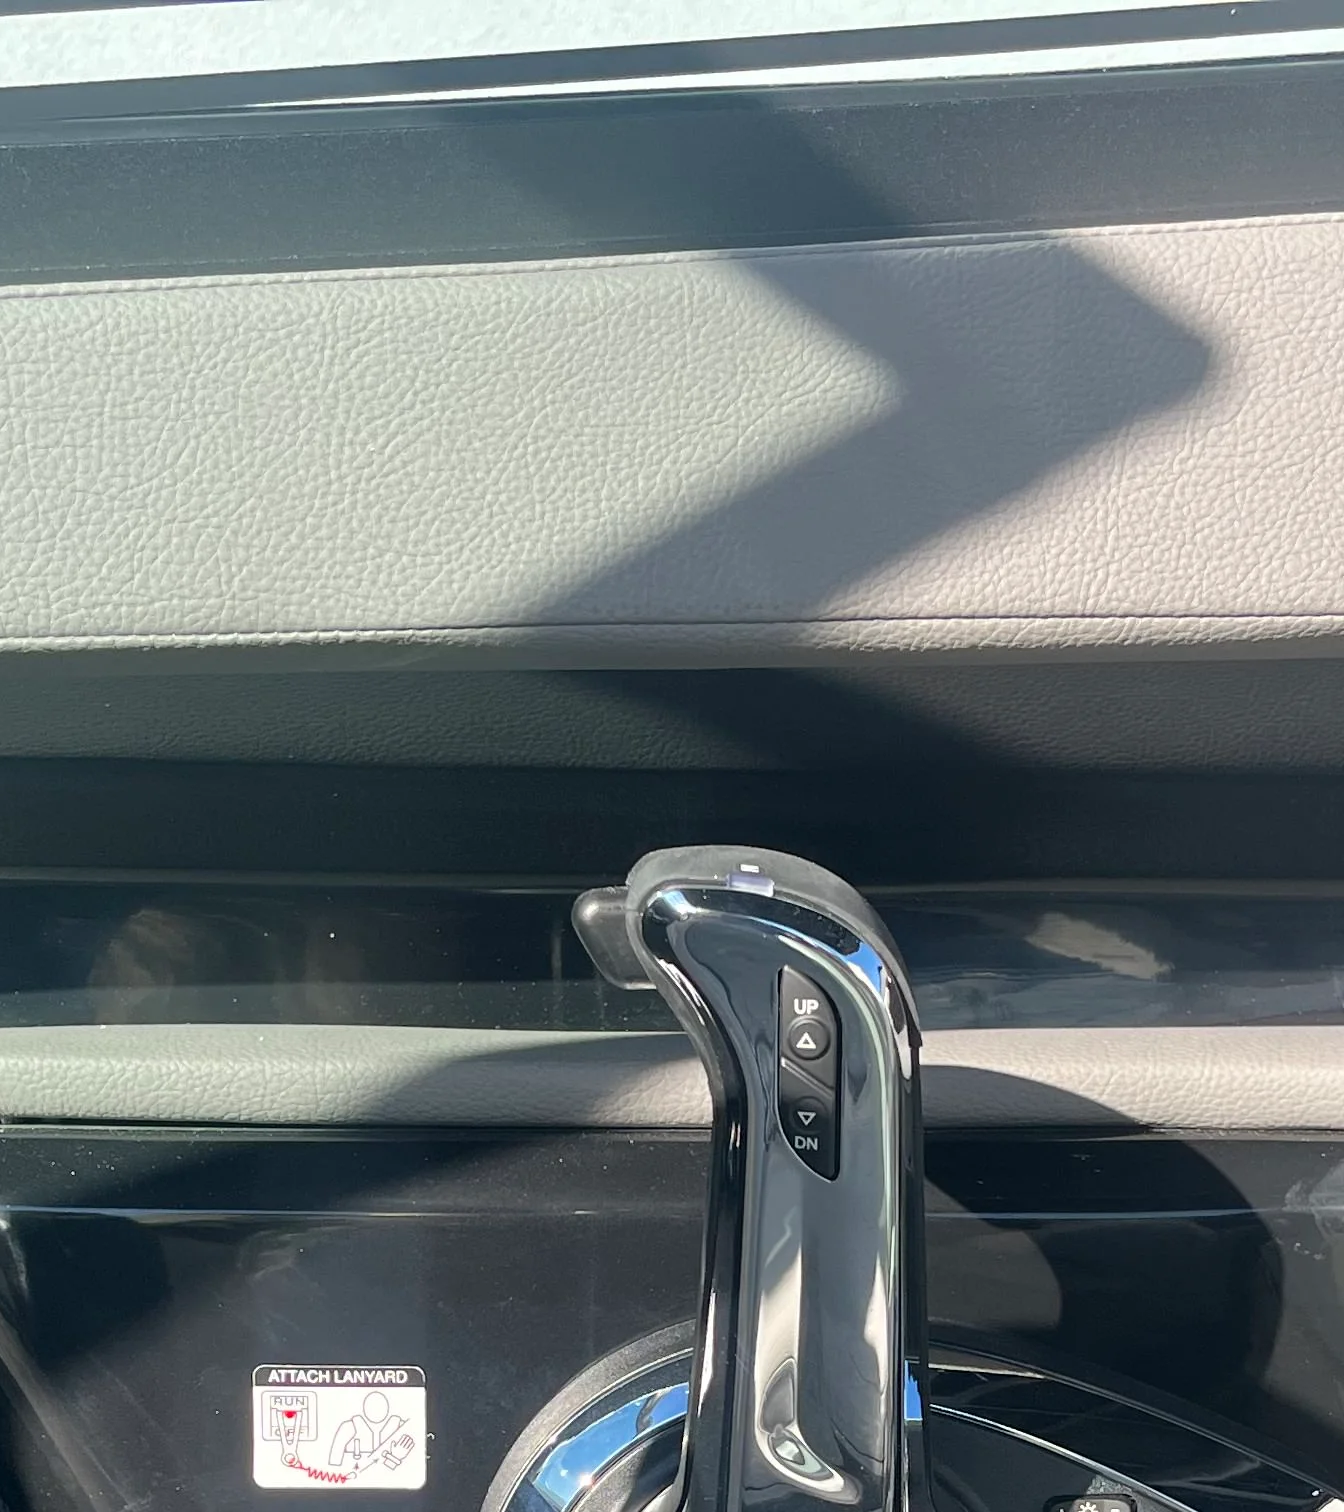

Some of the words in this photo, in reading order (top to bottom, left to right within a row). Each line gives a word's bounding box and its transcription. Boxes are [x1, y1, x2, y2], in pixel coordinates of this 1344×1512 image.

[793, 998, 820, 1015] UP
[794, 1136, 819, 1151] DN
[268, 1369, 330, 1384] ATTACH
[334, 1369, 408, 1384] LANYARD
[273, 1397, 305, 1407] RUN
